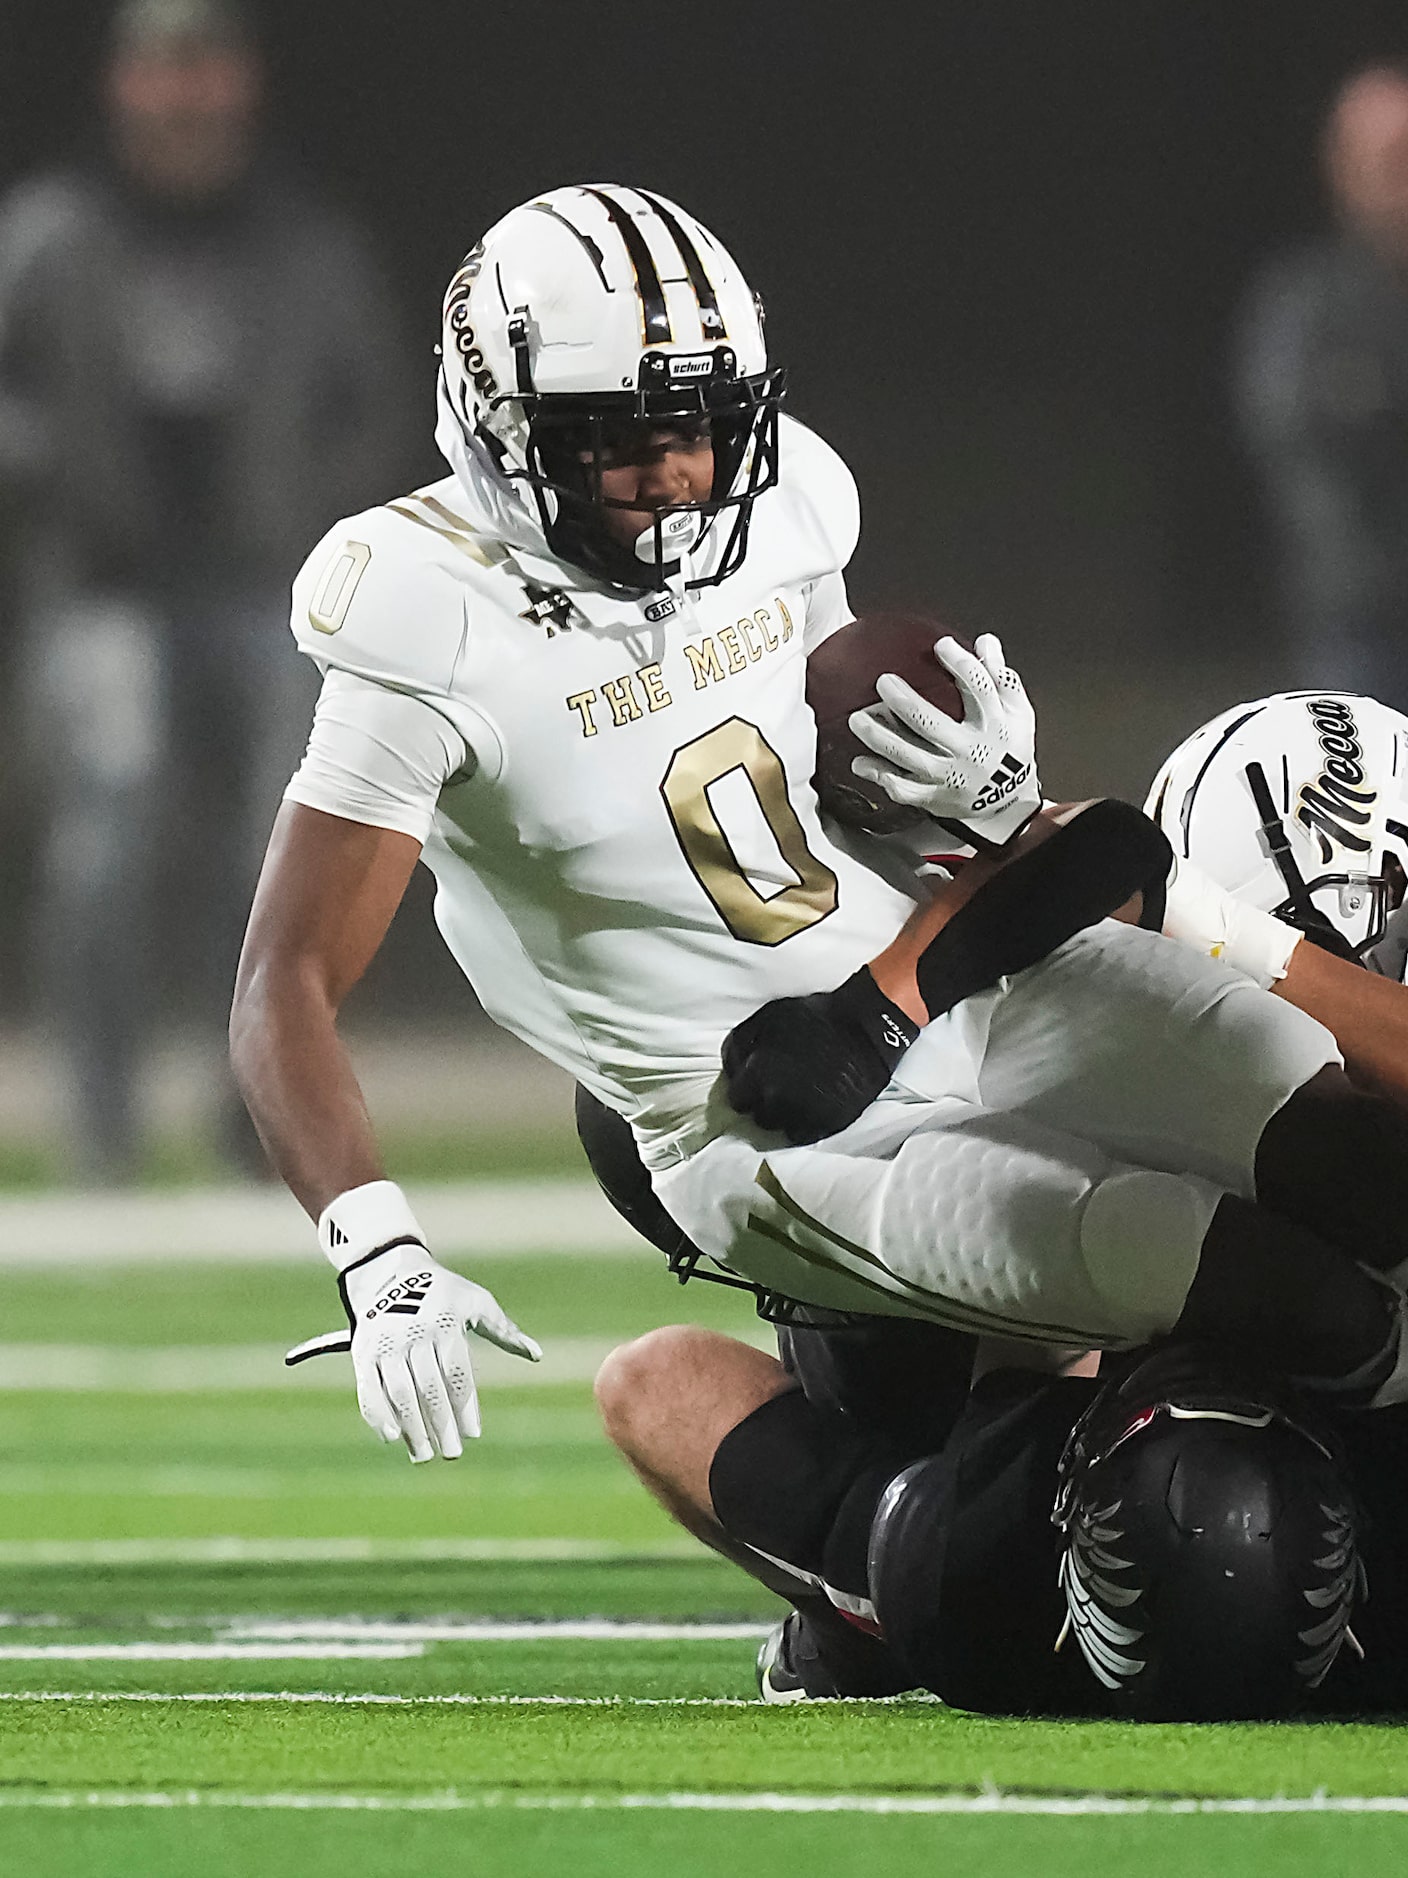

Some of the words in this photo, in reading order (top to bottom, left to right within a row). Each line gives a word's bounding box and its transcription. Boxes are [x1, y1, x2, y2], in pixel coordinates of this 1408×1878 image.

[673, 362, 710, 374] schutt
[308, 539, 372, 636] 0
[566, 662, 673, 738] THE
[683, 597, 795, 691] MECCA
[659, 715, 840, 948] 0
[1296, 698, 1378, 865] Mecca
[366, 1272, 433, 1319] adidas
